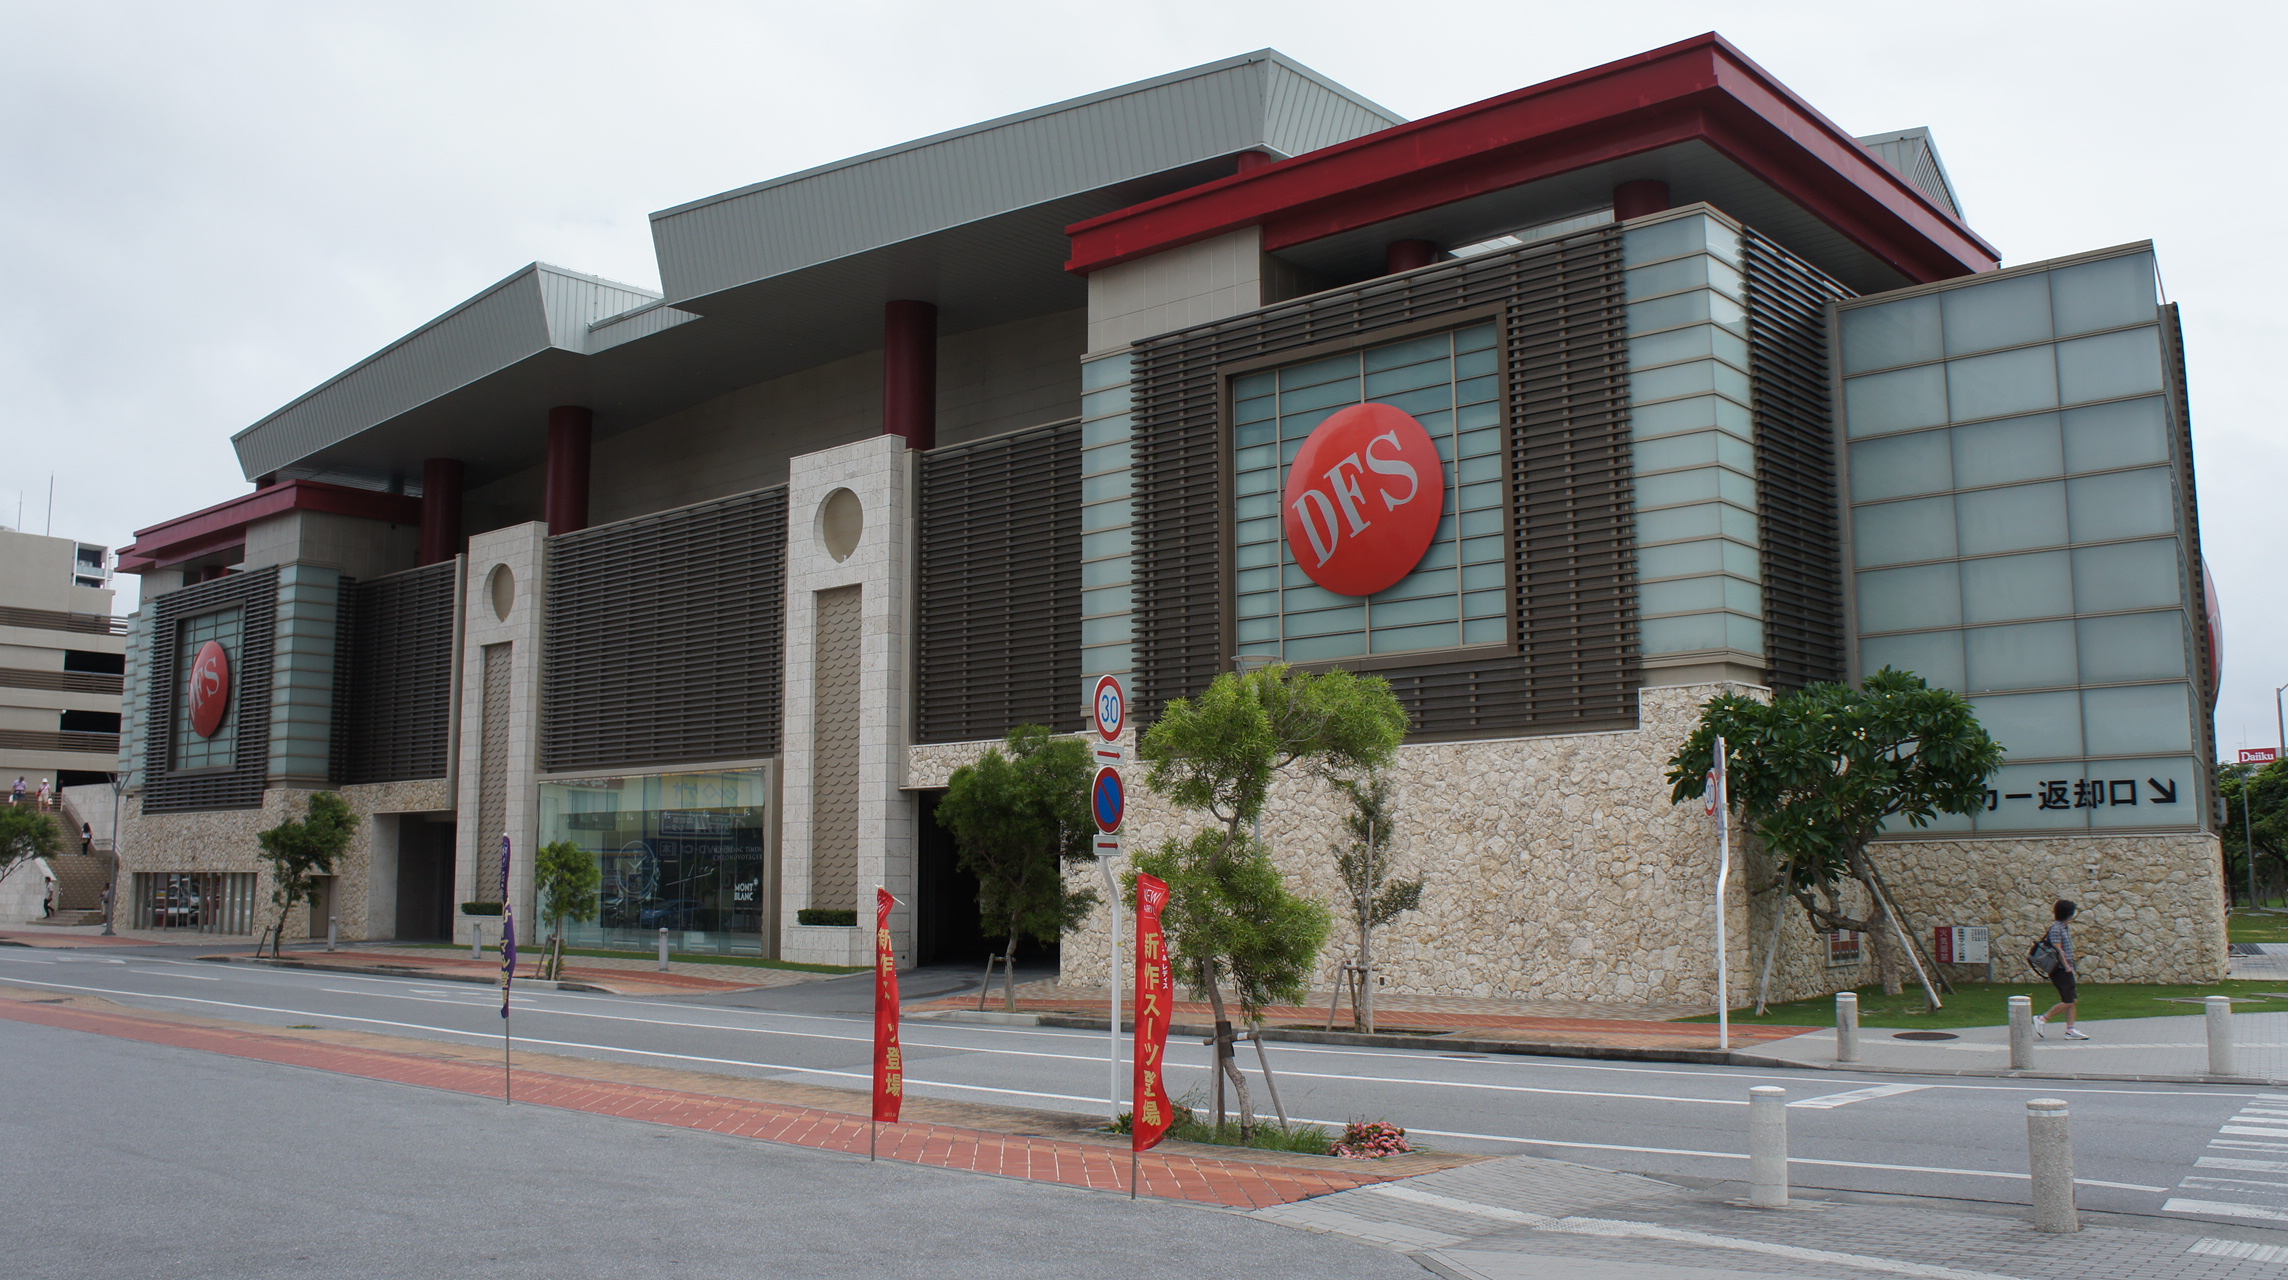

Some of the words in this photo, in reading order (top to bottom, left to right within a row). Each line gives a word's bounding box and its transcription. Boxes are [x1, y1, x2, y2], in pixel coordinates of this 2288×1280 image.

[1292, 429, 1419, 569] DFS
[1102, 694, 1119, 724] 30
[2240, 751, 2275, 762] Daiiku
[1980, 778, 2138, 812] カー返却口
[734, 883, 753, 891] MONT
[734, 892, 753, 901] BLANC
[1142, 931, 1162, 1126] 新作スーツ登場
